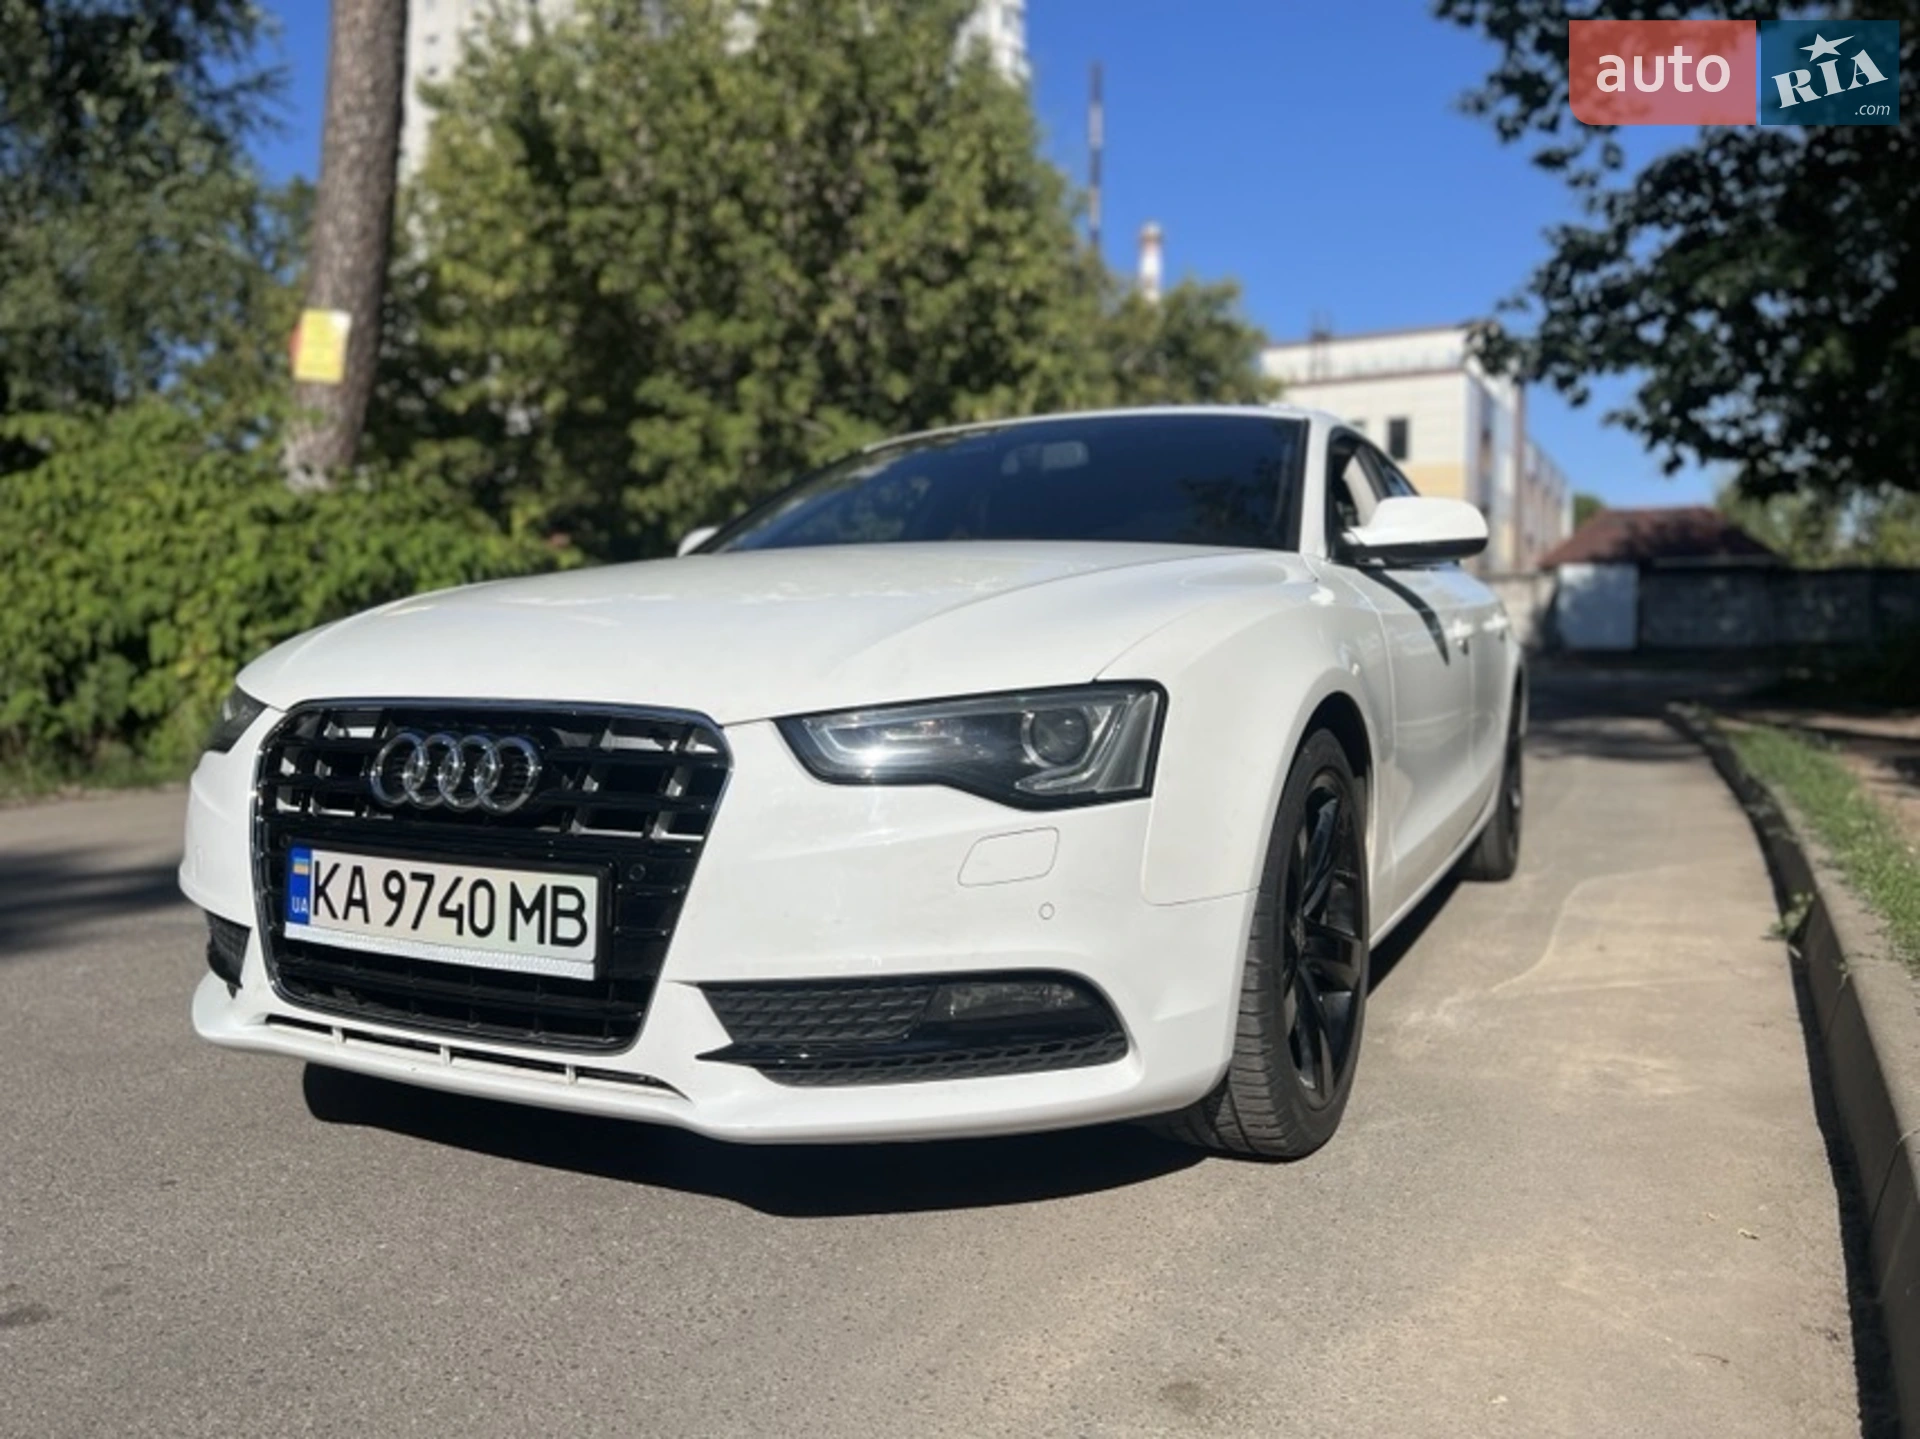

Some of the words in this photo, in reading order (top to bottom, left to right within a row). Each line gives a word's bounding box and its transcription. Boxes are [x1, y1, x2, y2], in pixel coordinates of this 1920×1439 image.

[291, 895, 309, 914] UA
[313, 860, 370, 924] KA
[382, 869, 496, 938] 9740
[508, 881, 588, 948] MB
